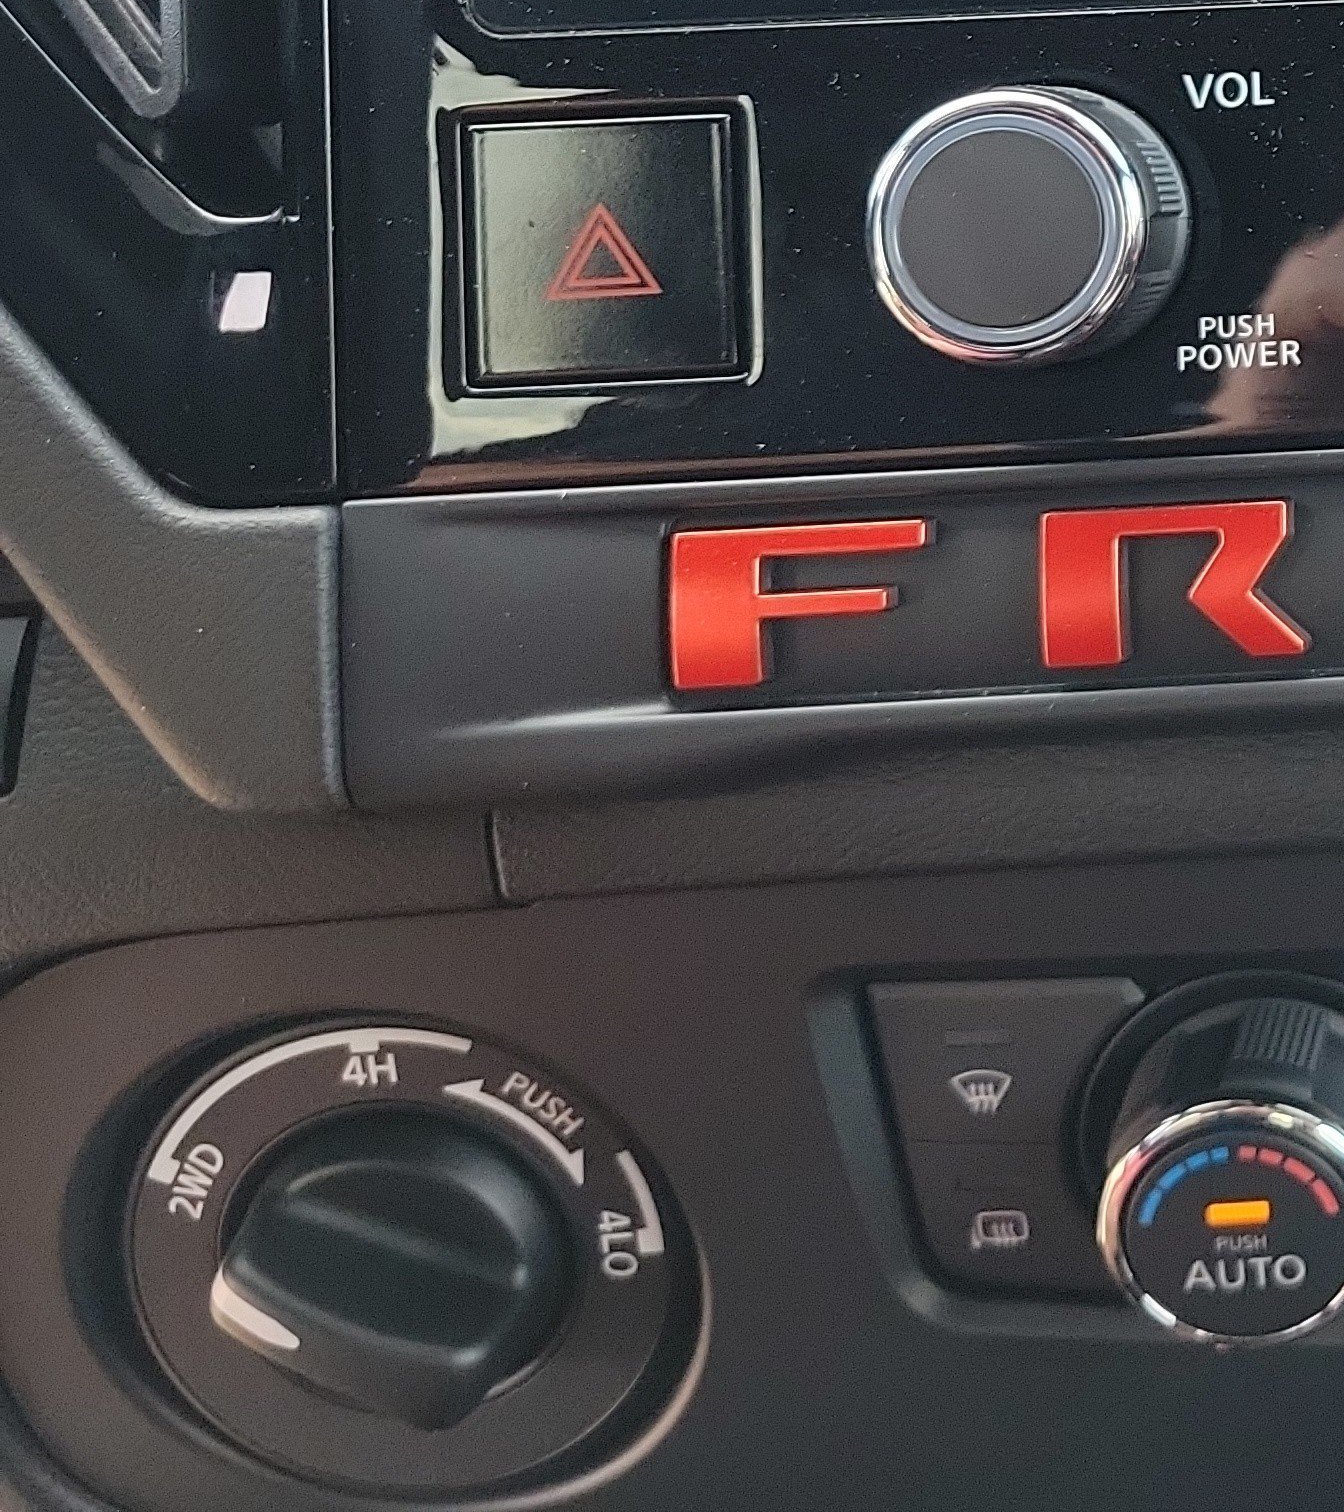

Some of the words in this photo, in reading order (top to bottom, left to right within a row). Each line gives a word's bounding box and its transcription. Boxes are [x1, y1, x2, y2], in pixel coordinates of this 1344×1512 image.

[1182, 71, 1276, 109] VOL
[1200, 313, 1276, 339] PUSH
[1176, 339, 1303, 371] POWER
[341, 1053, 399, 1086] 4H
[502, 1071, 586, 1136] PUSH
[167, 1142, 226, 1220] 2WD
[599, 1209, 641, 1278] 4LO
[1215, 1233, 1268, 1252] PUSH
[1184, 1253, 1307, 1291] AUTO
